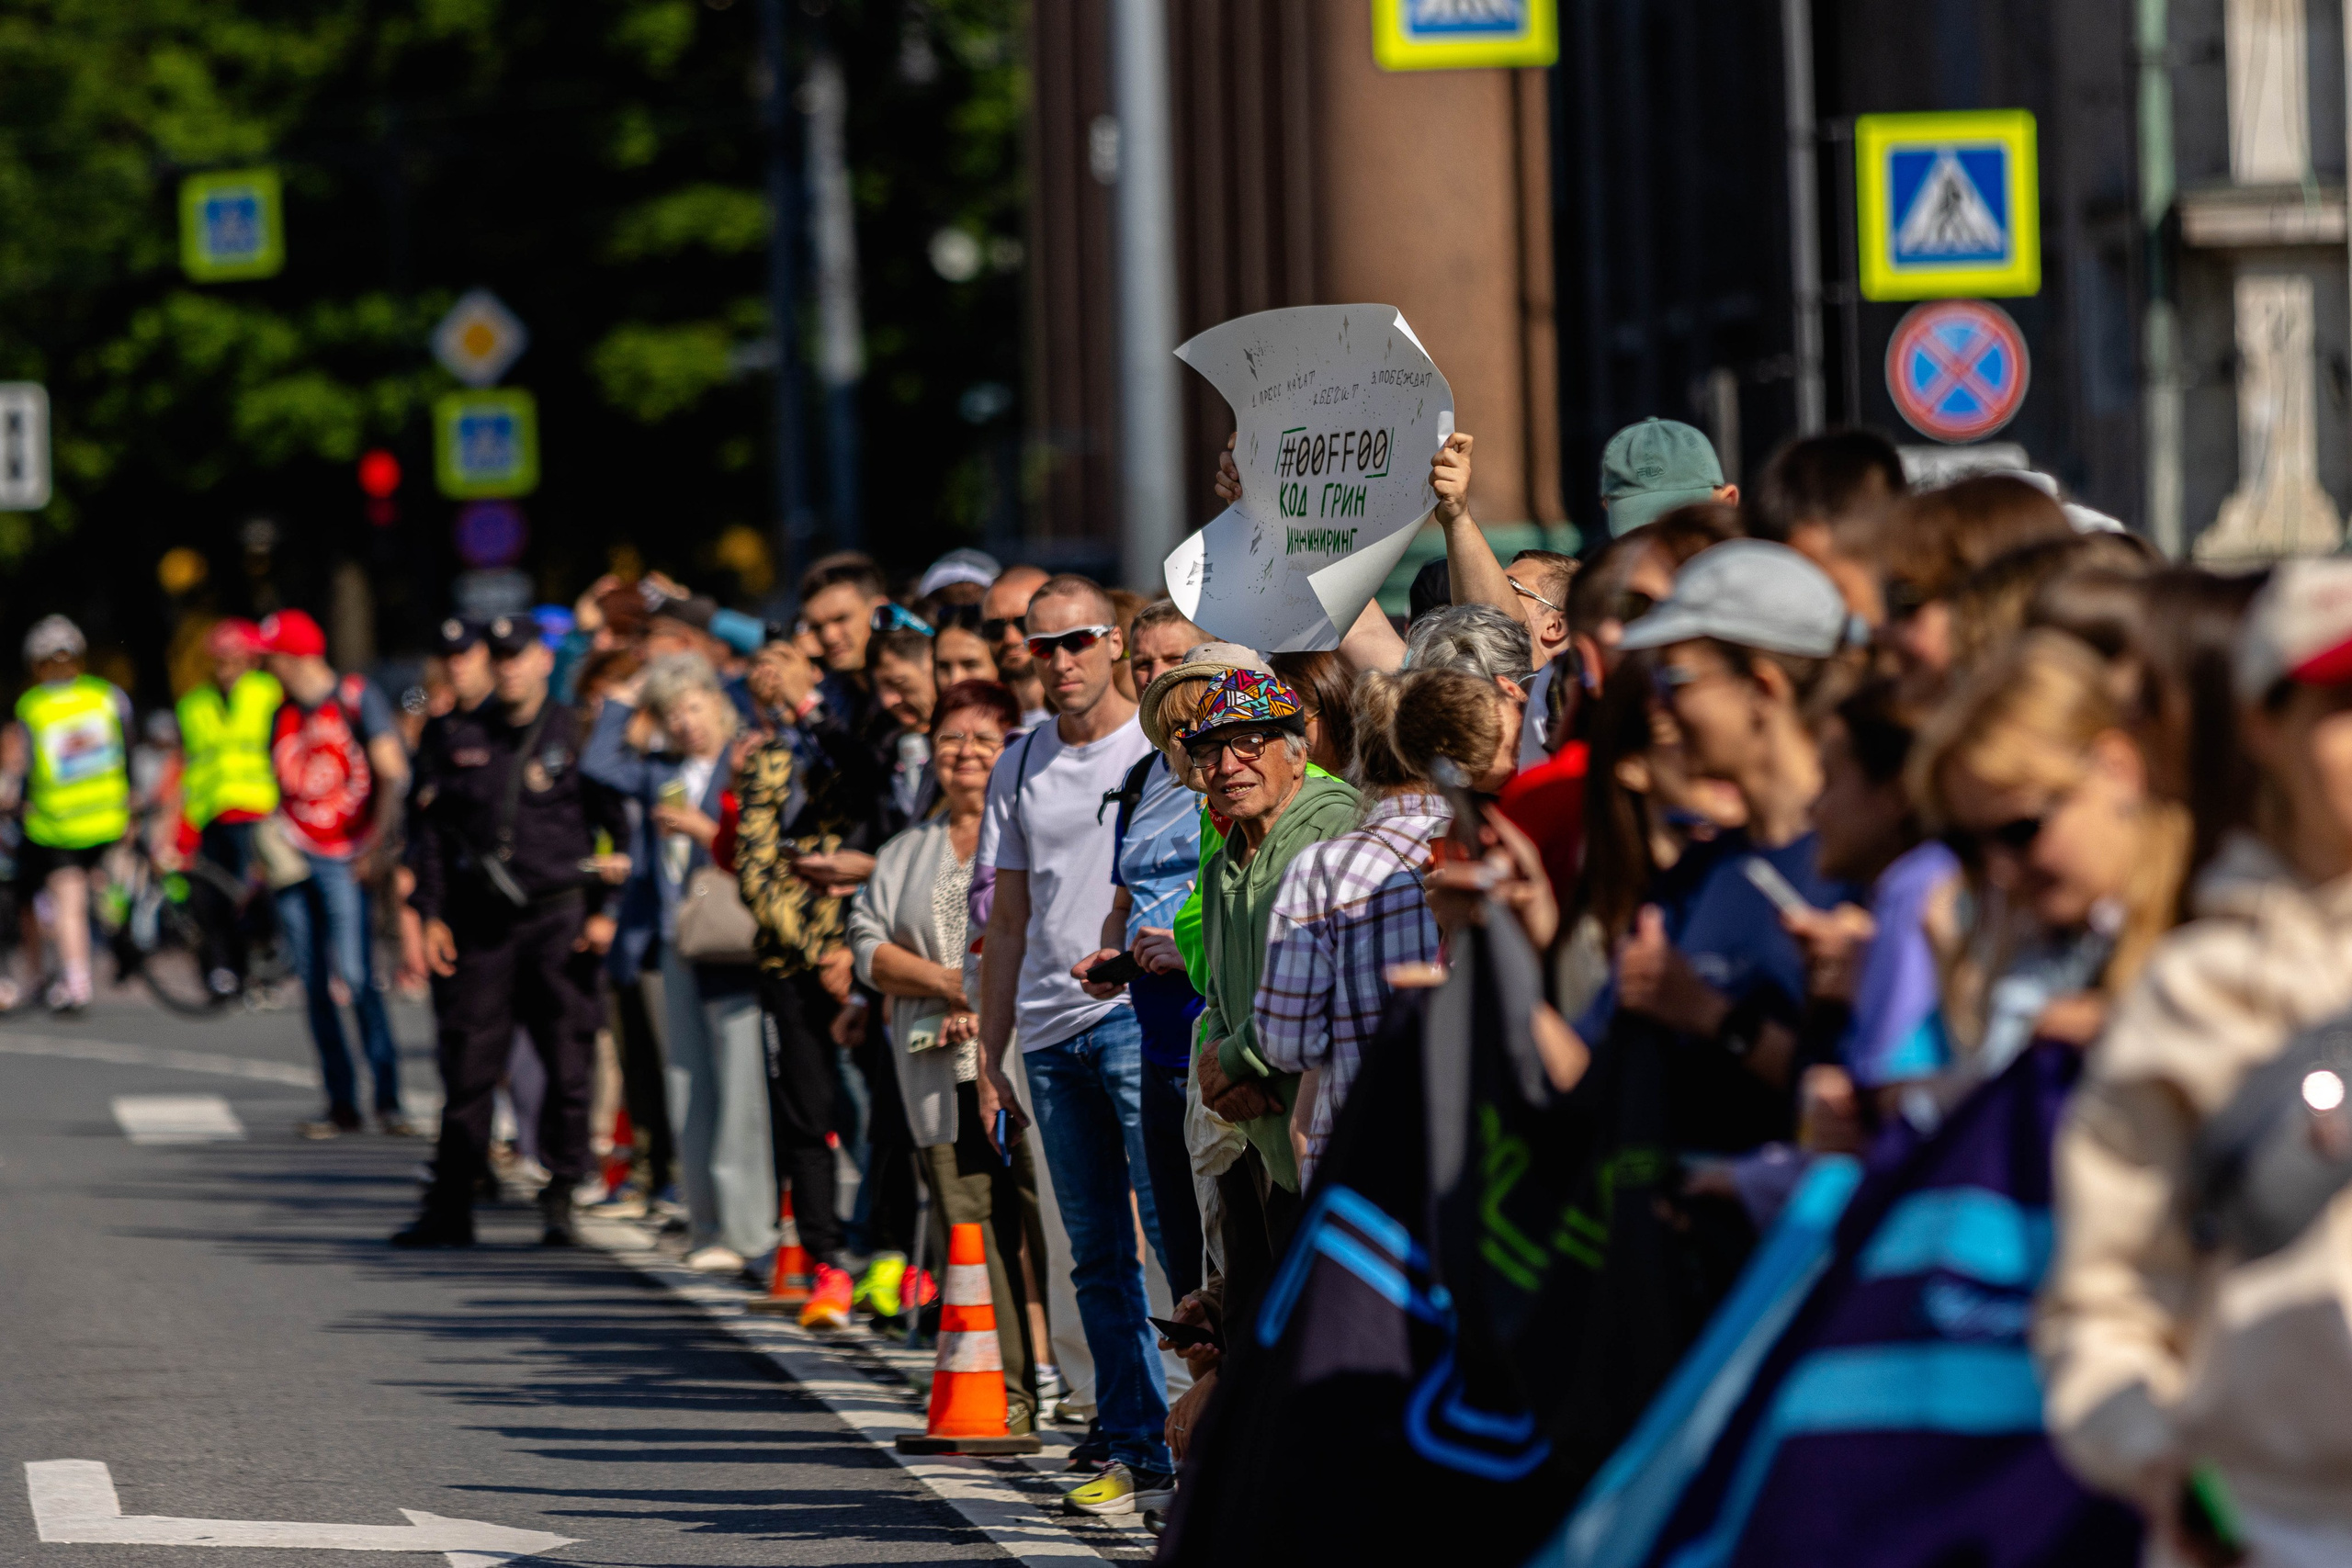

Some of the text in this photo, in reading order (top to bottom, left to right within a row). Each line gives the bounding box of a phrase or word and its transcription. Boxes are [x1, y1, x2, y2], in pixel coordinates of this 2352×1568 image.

[1260, 383, 1282, 405] ПРЕСС
[1280, 429, 1388, 477] #00FF00
[1279, 481, 1367, 519] КОД ГРИН
[1285, 525, 1358, 558] ИНЖИНИРИНГ
